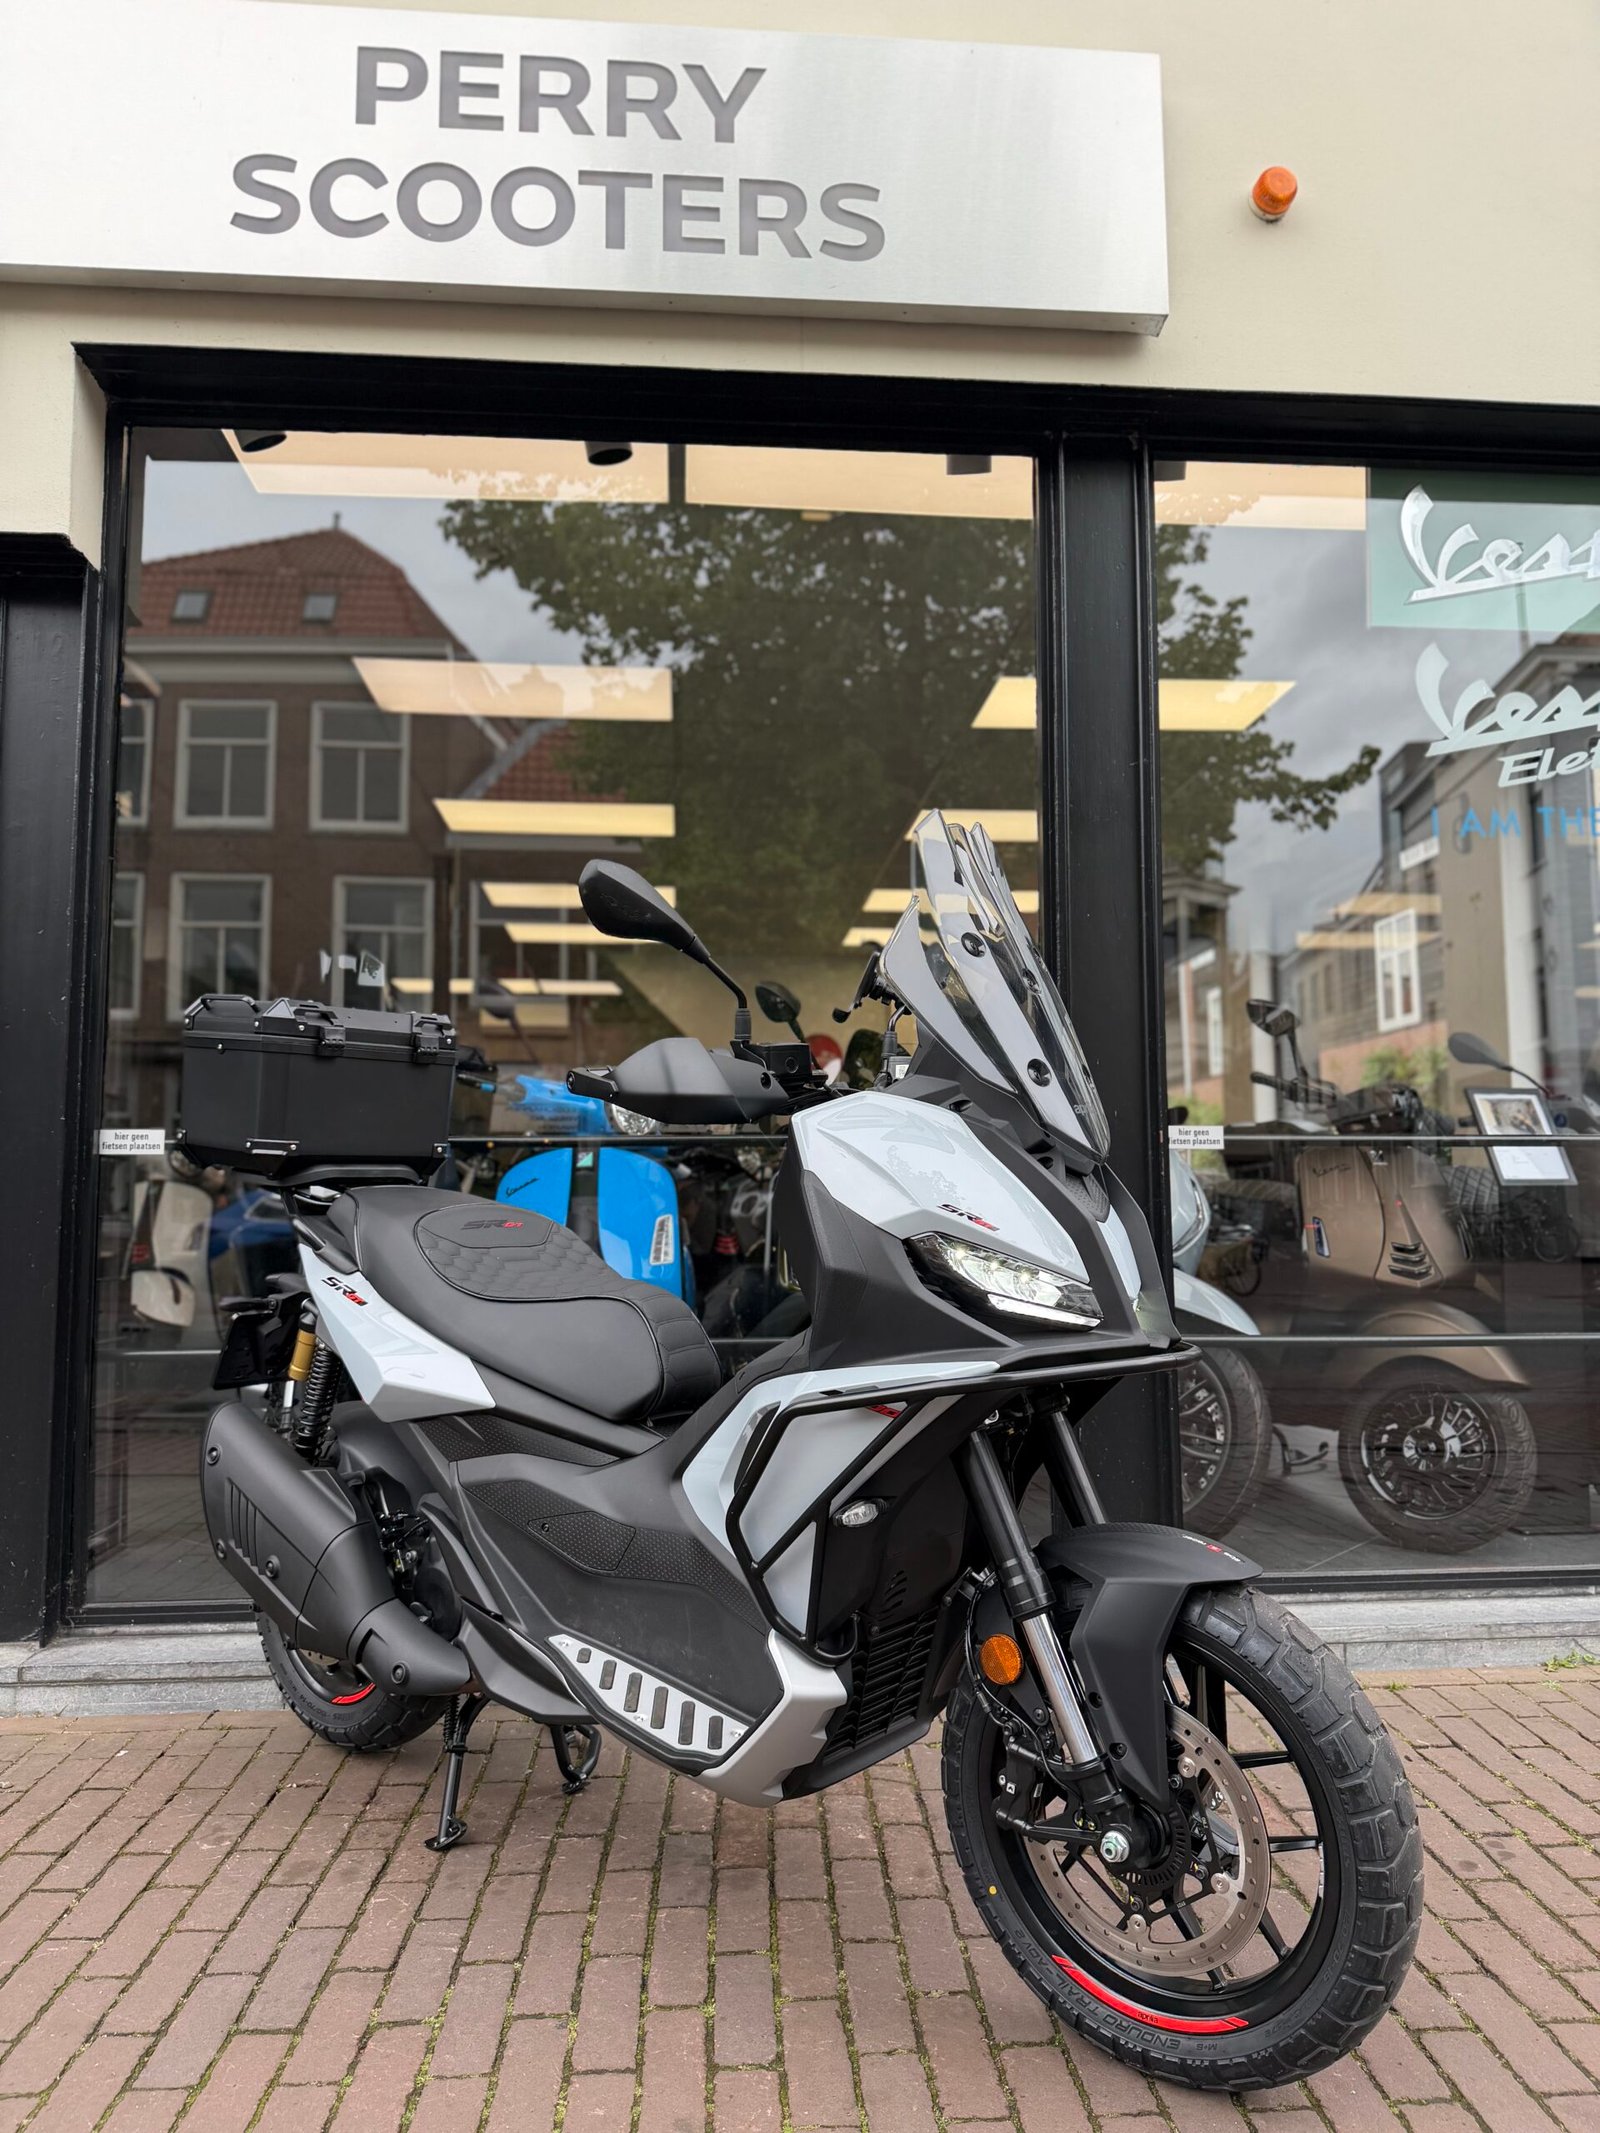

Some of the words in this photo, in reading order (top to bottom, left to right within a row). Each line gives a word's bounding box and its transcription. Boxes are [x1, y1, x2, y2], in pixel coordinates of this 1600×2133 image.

[355, 45, 767, 143] PERRY
[230, 153, 885, 262] SCOOTERS
[1430, 806, 1439, 837] I
[1459, 806, 1521, 838] AM
[114, 1132, 129, 1140] hier
[131, 1133, 149, 1142] geen
[1178, 1128, 1192, 1136] hier
[1193, 1129, 1209, 1137] geen
[1192, 1138, 1221, 1147] plaatsen
[102, 1141, 128, 1150] fietsen
[129, 1142, 161, 1151] plaatsen
[1102, 2014, 1182, 2051] ENDURO
